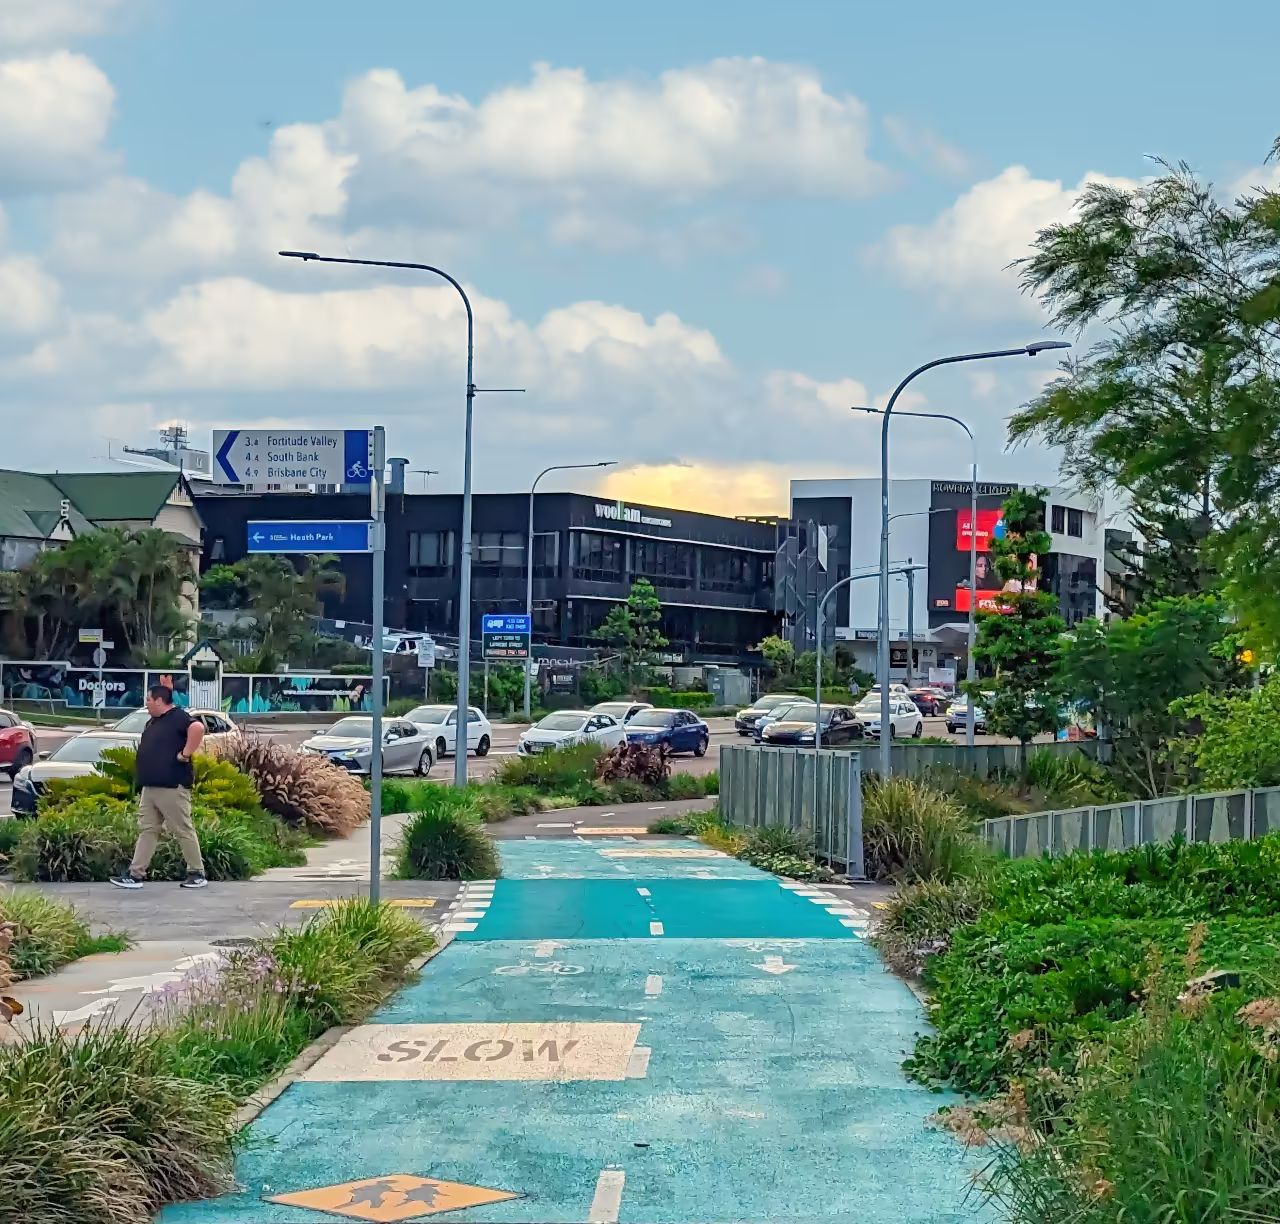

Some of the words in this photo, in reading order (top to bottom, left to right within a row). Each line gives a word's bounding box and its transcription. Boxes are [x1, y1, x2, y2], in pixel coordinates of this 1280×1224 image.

[267, 436, 308, 447] Fortitude
[310, 436, 337, 448] Valley
[267, 452, 293, 462] South
[297, 452, 319, 462] Bank
[267, 467, 307, 477] Brisbane
[310, 467, 327, 479] City
[595, 501, 640, 523] woollam
[79, 678, 126, 692] Doctors
[376, 1039, 579, 1062] SLOW
